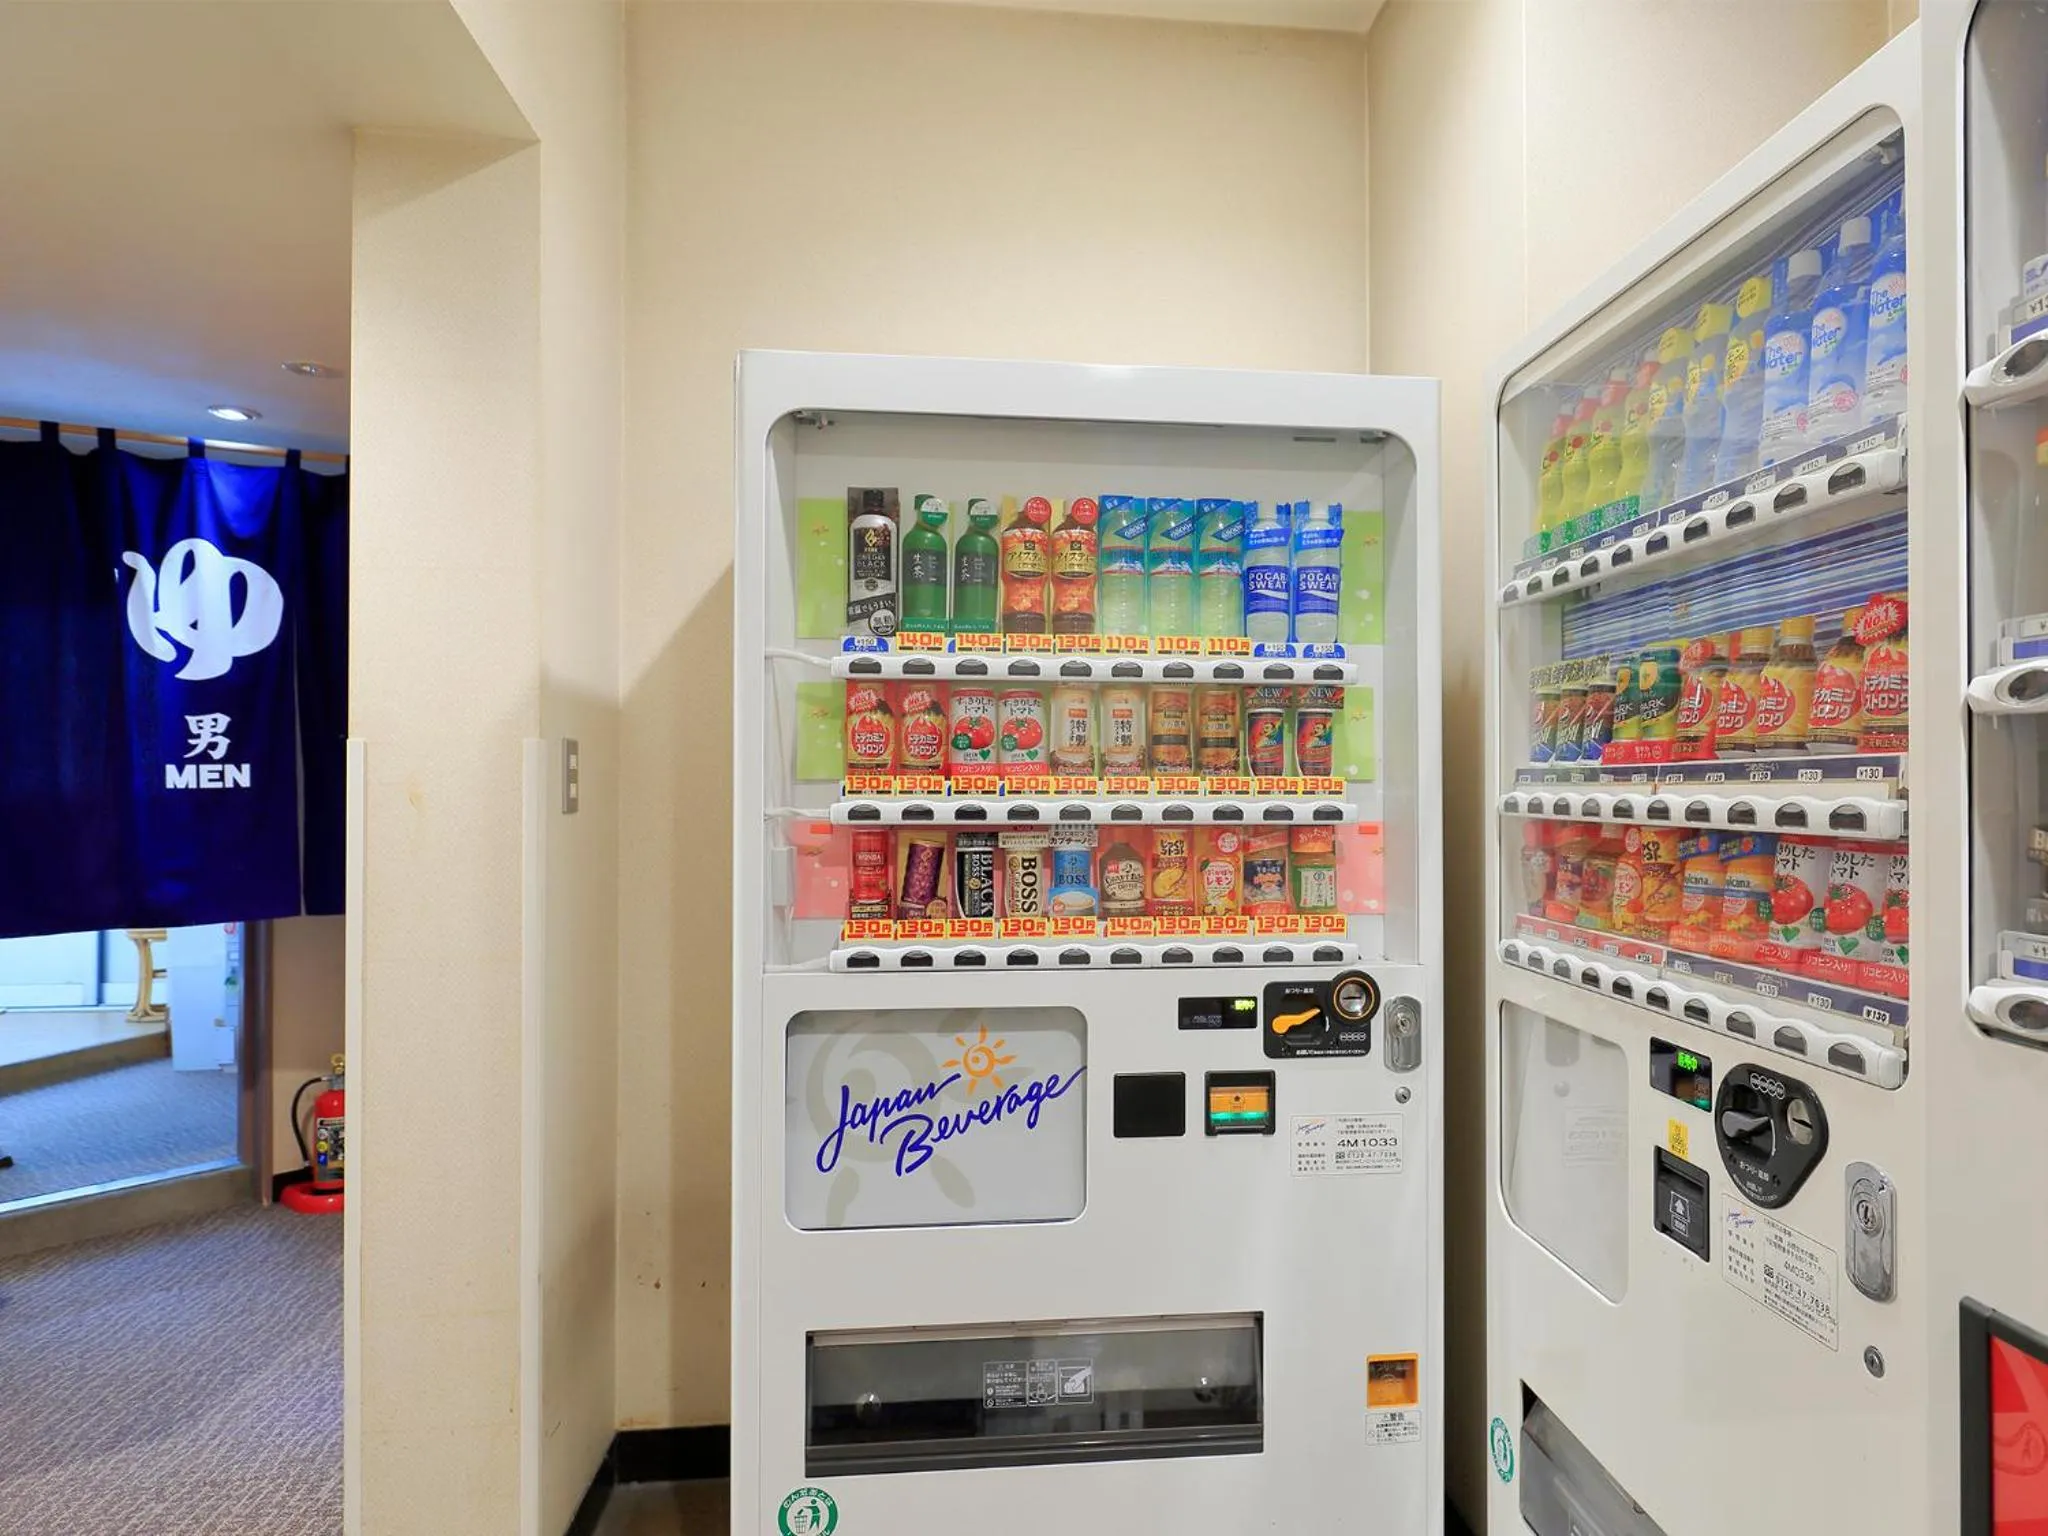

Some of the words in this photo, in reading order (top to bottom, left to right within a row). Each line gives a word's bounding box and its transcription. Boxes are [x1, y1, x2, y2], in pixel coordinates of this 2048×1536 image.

[1249, 582, 1287, 590] SWEAT
[1300, 582, 1338, 590] SWEAT
[898, 634, 943, 646] 140円
[957, 634, 1002, 647] 140円
[1008, 635, 1051, 648] 130円
[1057, 636, 1100, 648] 130円
[1106, 638, 1148, 648] 110円
[1158, 638, 1200, 650] 110円
[1208, 639, 1250, 650] 110円
[183, 712, 232, 760] 男
[165, 763, 251, 789] MEN
[1859, 768, 1880, 779] ¥130
[847, 776, 892, 789] 130円
[898, 776, 943, 789] 130円
[953, 777, 996, 790] 130円
[1007, 777, 1050, 790] 130円
[1054, 778, 1097, 790] 130円
[1106, 778, 1149, 790] 130円
[1156, 778, 1200, 790] 130円
[1208, 778, 1250, 790] 130円
[1256, 778, 1299, 791] 130円
[1302, 778, 1343, 791] 130円
[972, 854, 980, 876] BOSS
[980, 854, 993, 914] BLACK
[1021, 857, 1038, 914] BOSS
[1058, 874, 1088, 885] BOSS
[848, 920, 892, 932] 130円
[900, 920, 944, 932] 130円
[950, 920, 994, 932] 130円
[1002, 918, 1046, 930] 130円
[1052, 918, 1095, 930] 130円
[1110, 918, 1152, 930] 140円
[1158, 917, 1200, 929] 130円
[1206, 917, 1248, 929] 130円
[1258, 917, 1298, 929] 130円
[1304, 916, 1344, 928] 130円
[1866, 1008, 1887, 1022] ¥130
[816, 1072, 962, 1173] Japan
[879, 1065, 1088, 1177] Beverage
[1337, 1138, 1398, 1147] 4M1033
